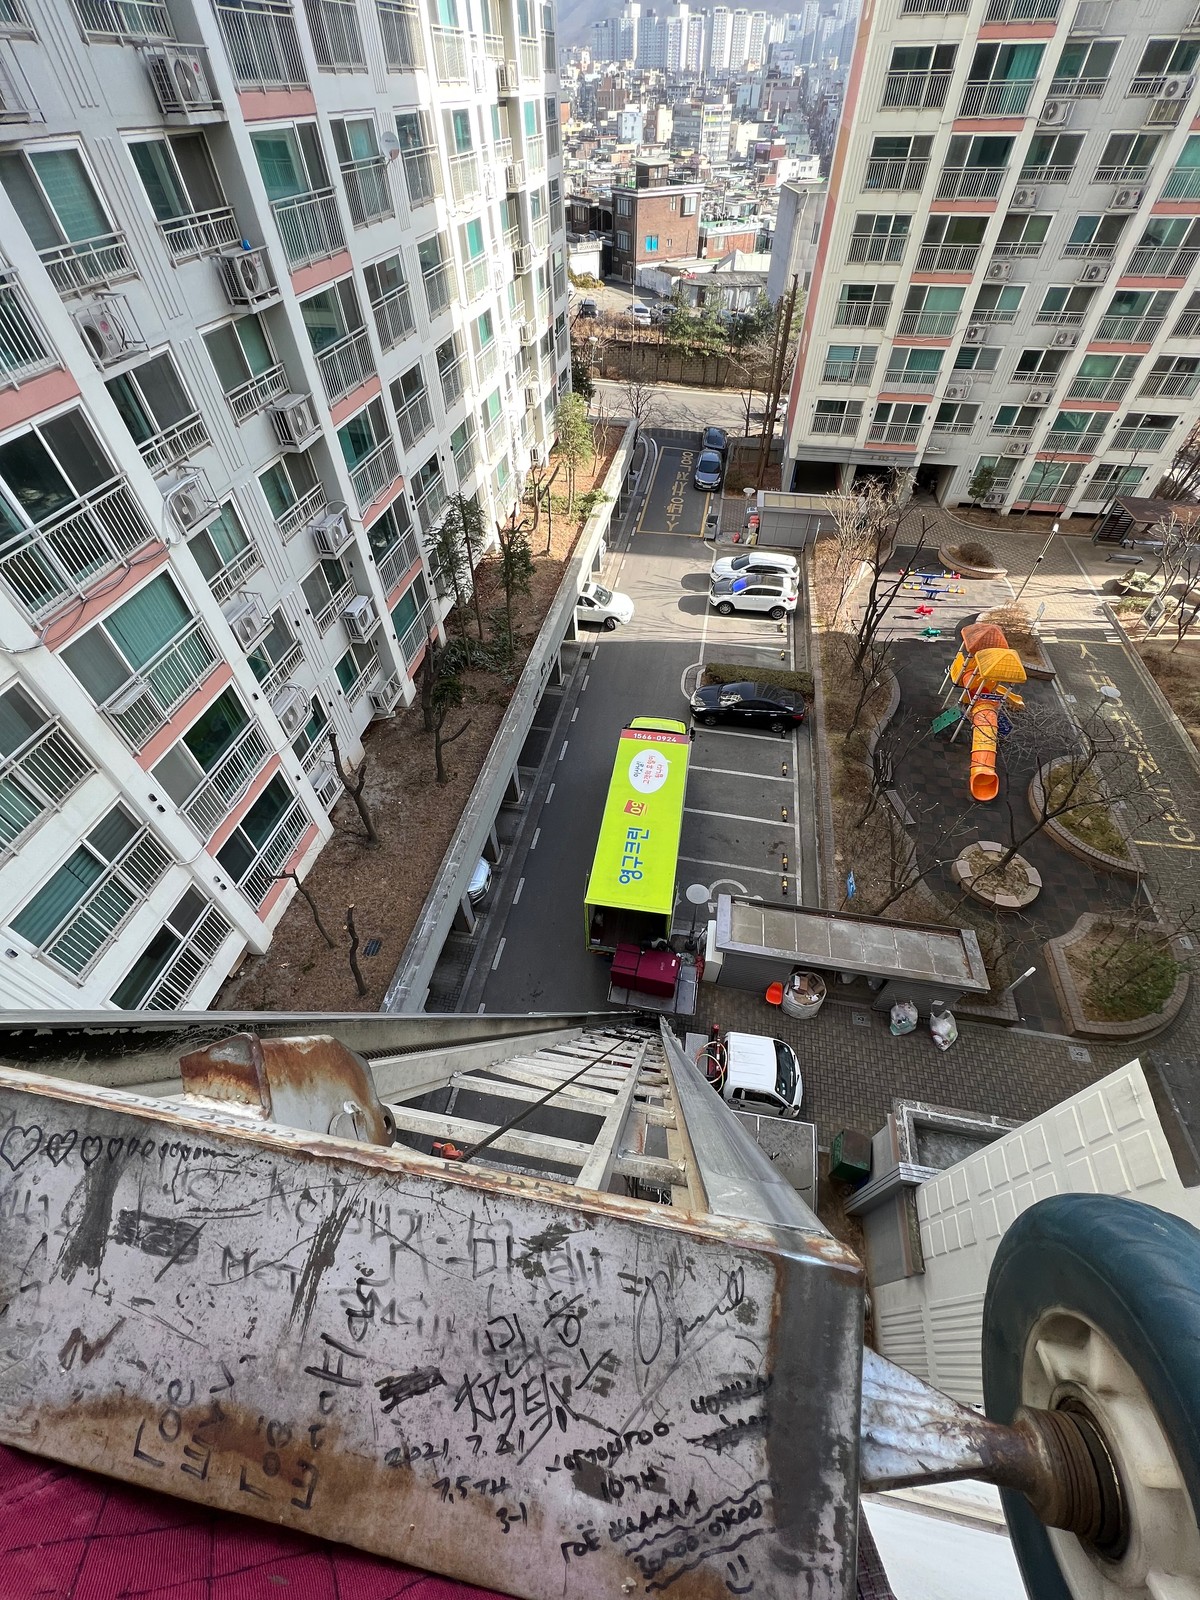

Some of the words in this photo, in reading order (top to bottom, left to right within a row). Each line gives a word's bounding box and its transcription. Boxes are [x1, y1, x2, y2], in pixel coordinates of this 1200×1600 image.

[666, 451, 693, 531] 소방차전용
[634, 733, 677, 743] 1566-0924
[618, 827, 650, 884] 영구크린
